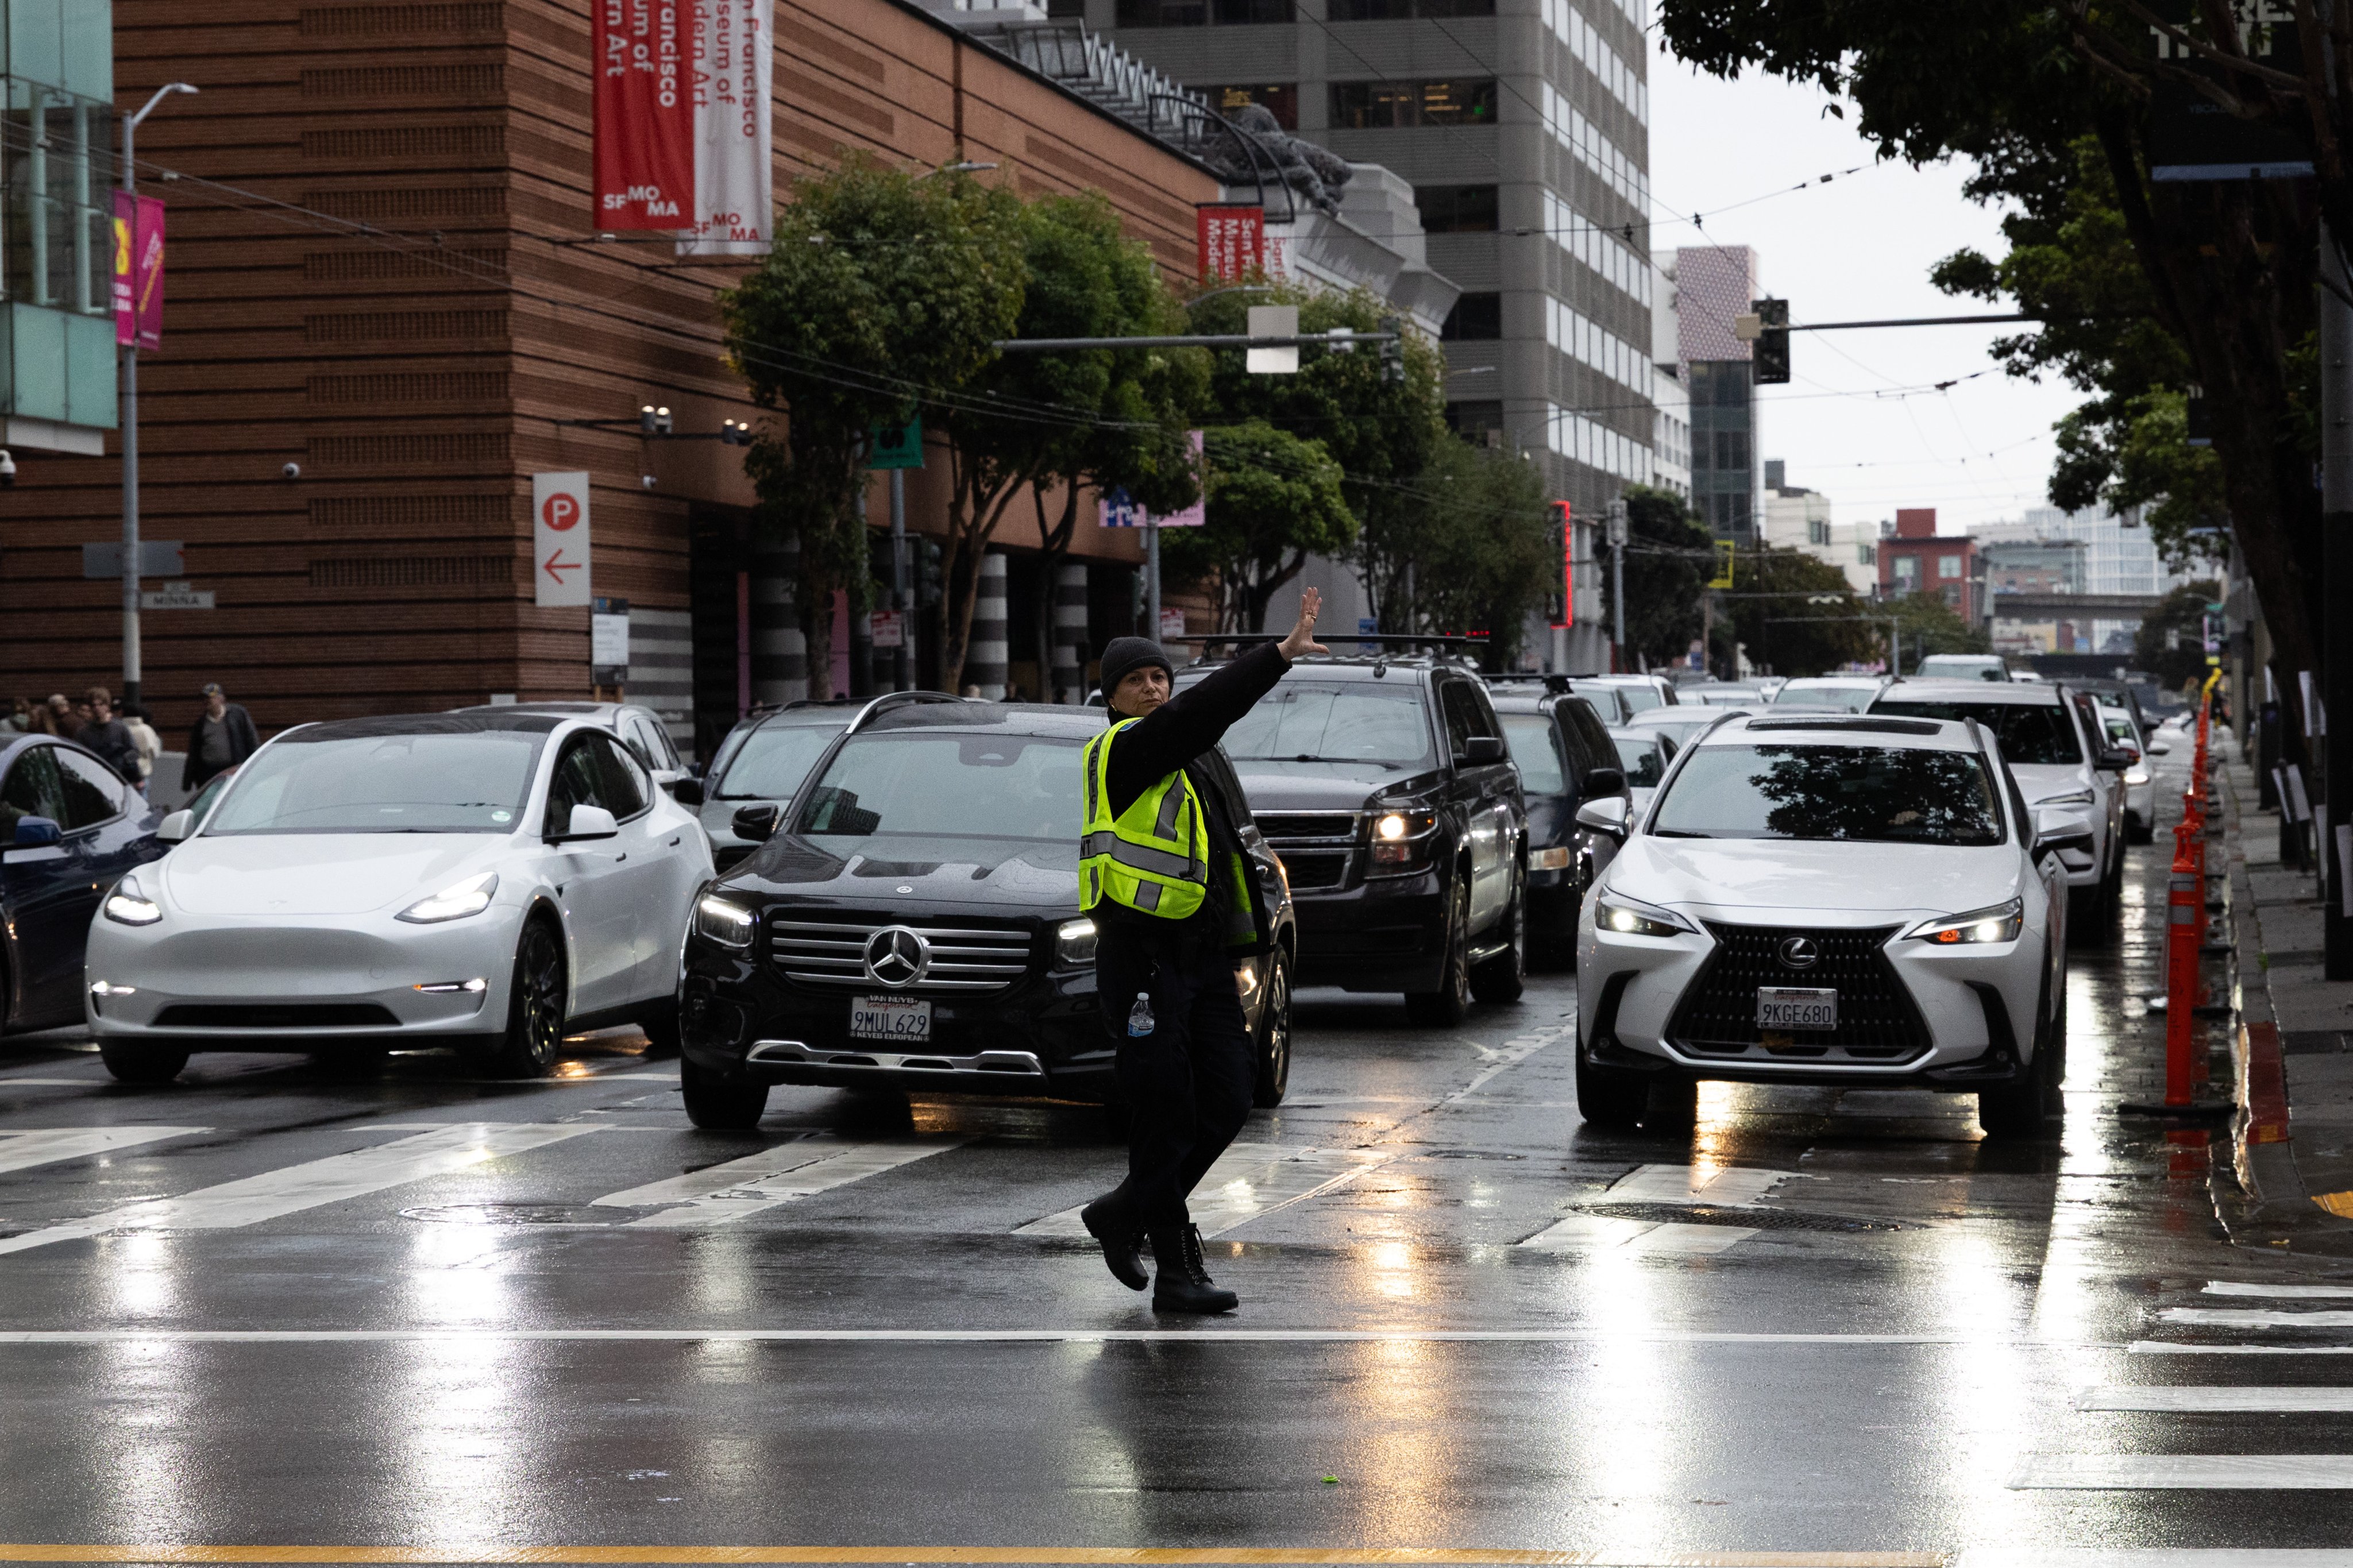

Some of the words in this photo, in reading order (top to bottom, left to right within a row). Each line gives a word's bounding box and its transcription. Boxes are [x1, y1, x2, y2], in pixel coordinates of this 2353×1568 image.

[716, 0, 730, 69] seum
[606, 34, 628, 77] Art
[633, 43, 654, 72] of
[692, 69, 711, 108] Art
[717, 78, 736, 105] of
[742, 18, 759, 137] Francisco
[1207, 218, 1222, 272] Mode
[1224, 219, 1239, 280] Museu
[1241, 218, 1256, 250] San
[552, 499, 572, 525] P
[855, 1011, 927, 1034] 9MUL629
[1763, 1004, 1831, 1023] 9KGE680
[884, 1033, 923, 1041] EUROPEAN
